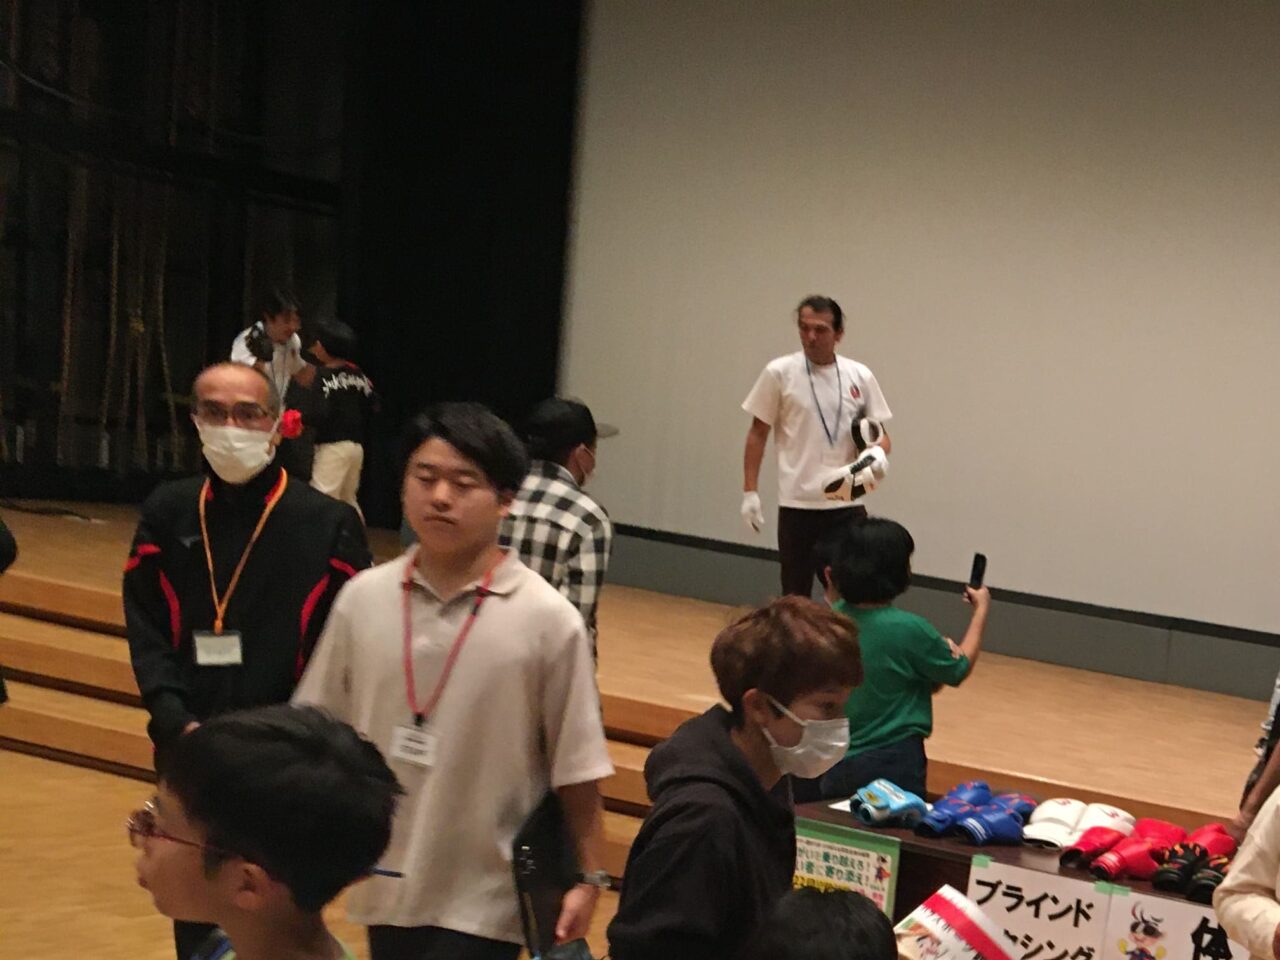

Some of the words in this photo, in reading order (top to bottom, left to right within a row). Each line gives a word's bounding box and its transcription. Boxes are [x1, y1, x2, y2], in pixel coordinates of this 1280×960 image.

[975, 879, 1094, 928] ブラインド
